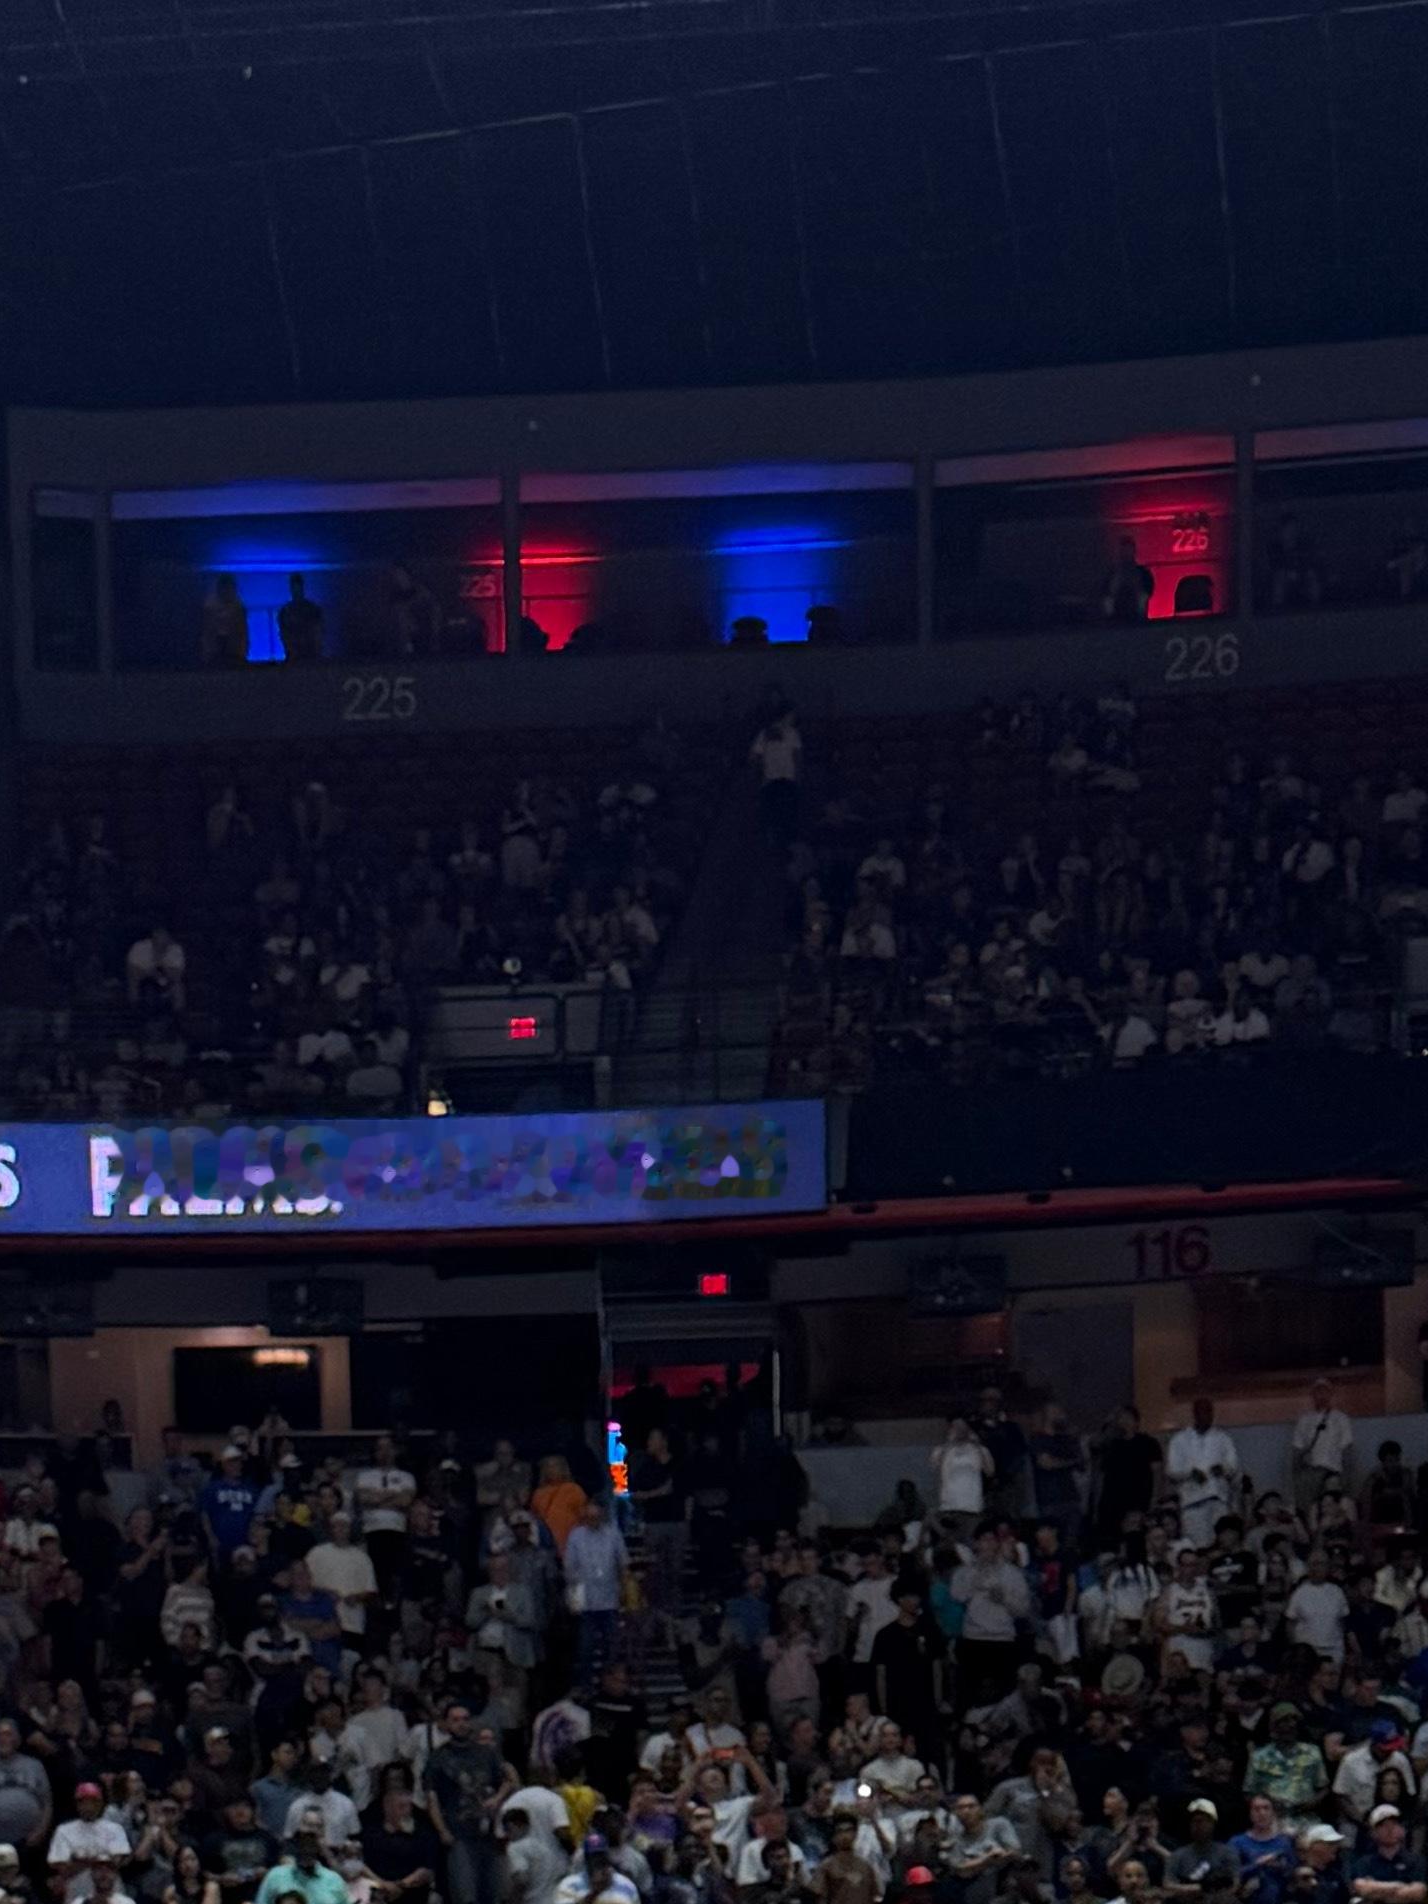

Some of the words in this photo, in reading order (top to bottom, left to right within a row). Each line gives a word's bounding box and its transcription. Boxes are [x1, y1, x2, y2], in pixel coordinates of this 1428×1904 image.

[1172, 526, 1209, 553] 226
[1165, 632, 1240, 682] 226
[342, 677, 417, 720] 225
[1127, 1224, 1210, 1279] 116
